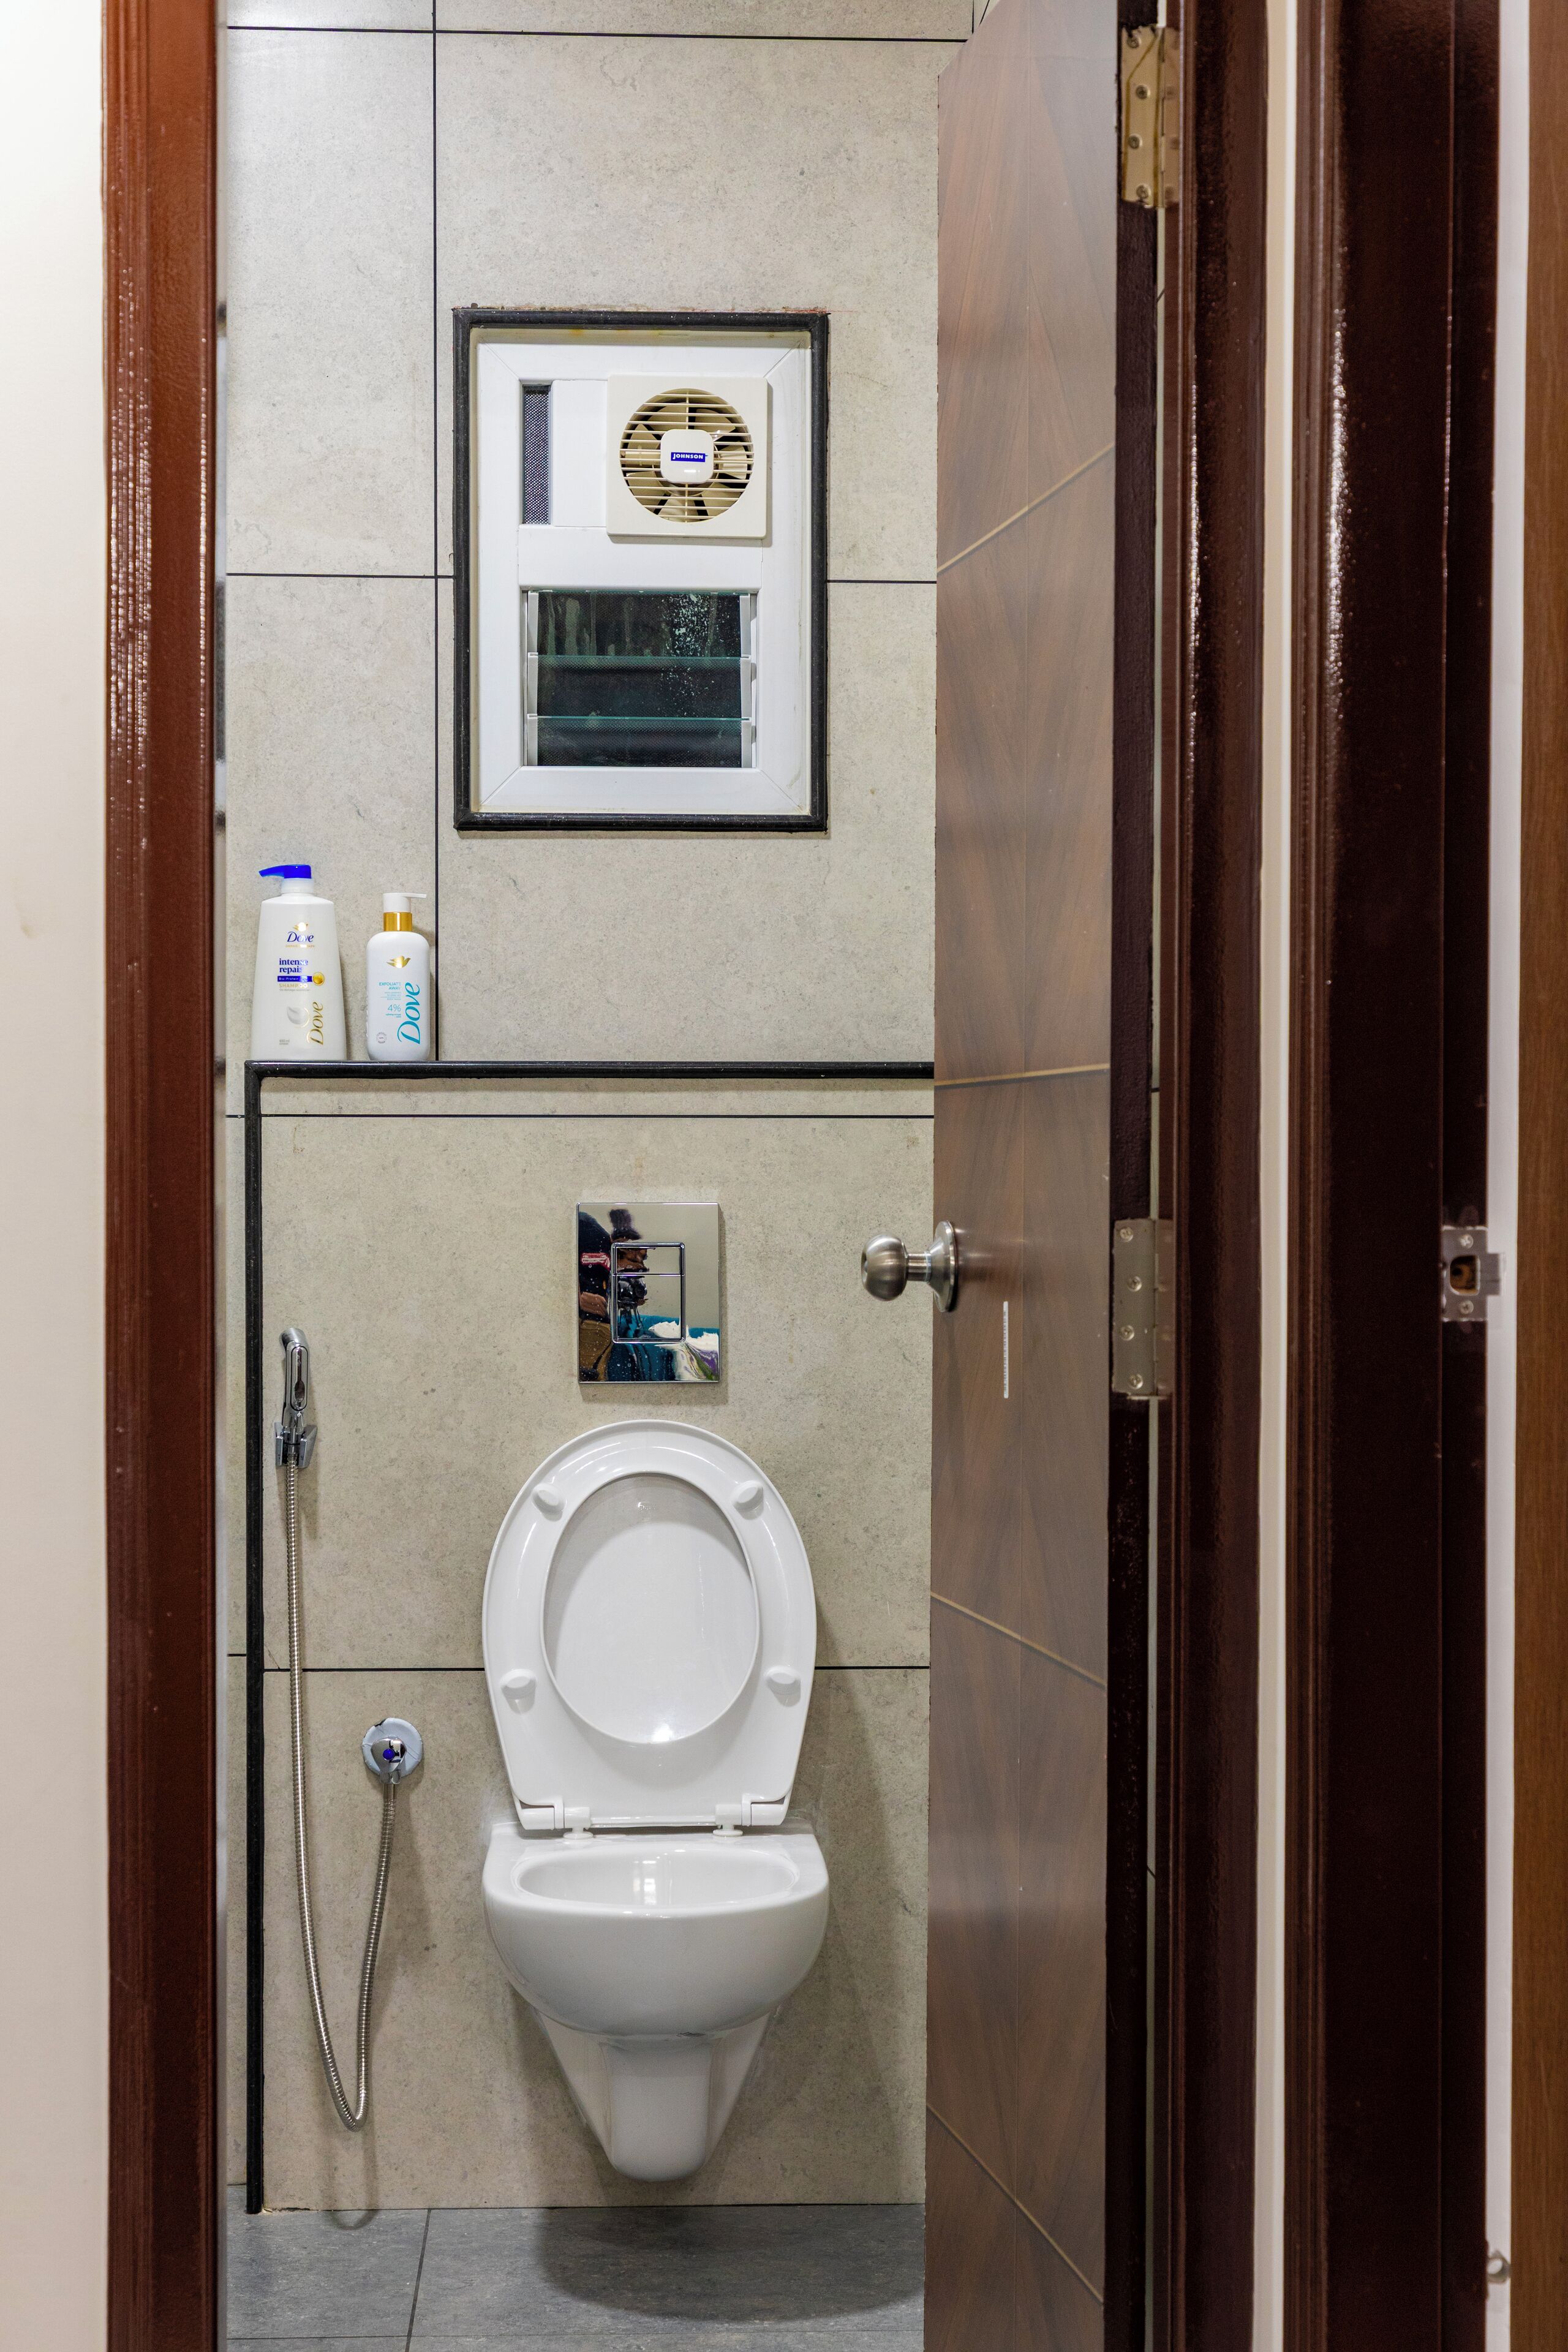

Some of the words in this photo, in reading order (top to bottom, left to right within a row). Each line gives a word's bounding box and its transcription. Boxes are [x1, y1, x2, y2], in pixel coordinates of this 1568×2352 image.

[287, 931, 314, 943] Dove
[279, 965, 304, 974] repair
[306, 1001, 323, 1045] Dove
[397, 982, 420, 1044] Dove
